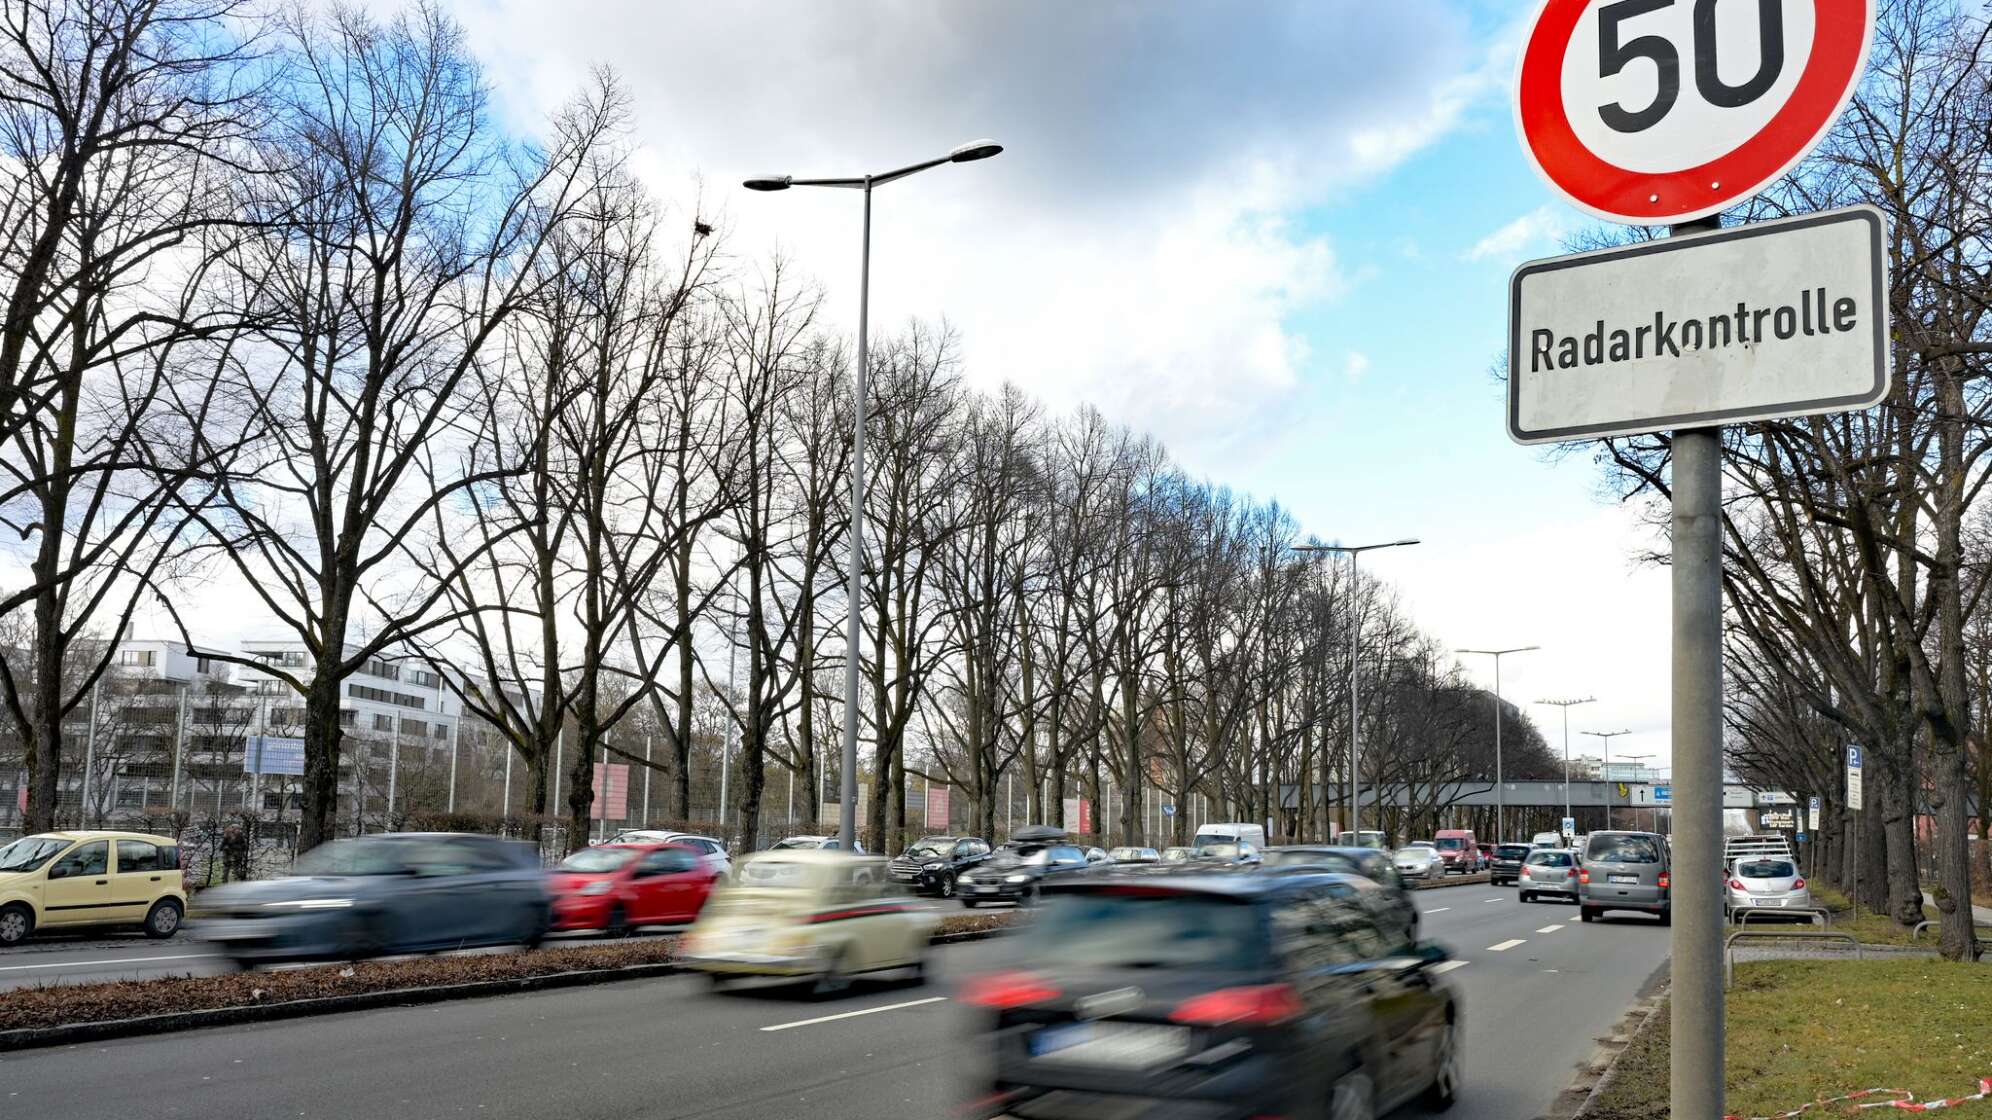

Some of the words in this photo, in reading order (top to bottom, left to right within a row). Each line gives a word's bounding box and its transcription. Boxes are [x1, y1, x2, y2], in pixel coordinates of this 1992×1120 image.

[1598, 0, 1784, 133] 50
[1531, 288, 1857, 373] Radarkontrolle
[1849, 748, 1858, 765] P
